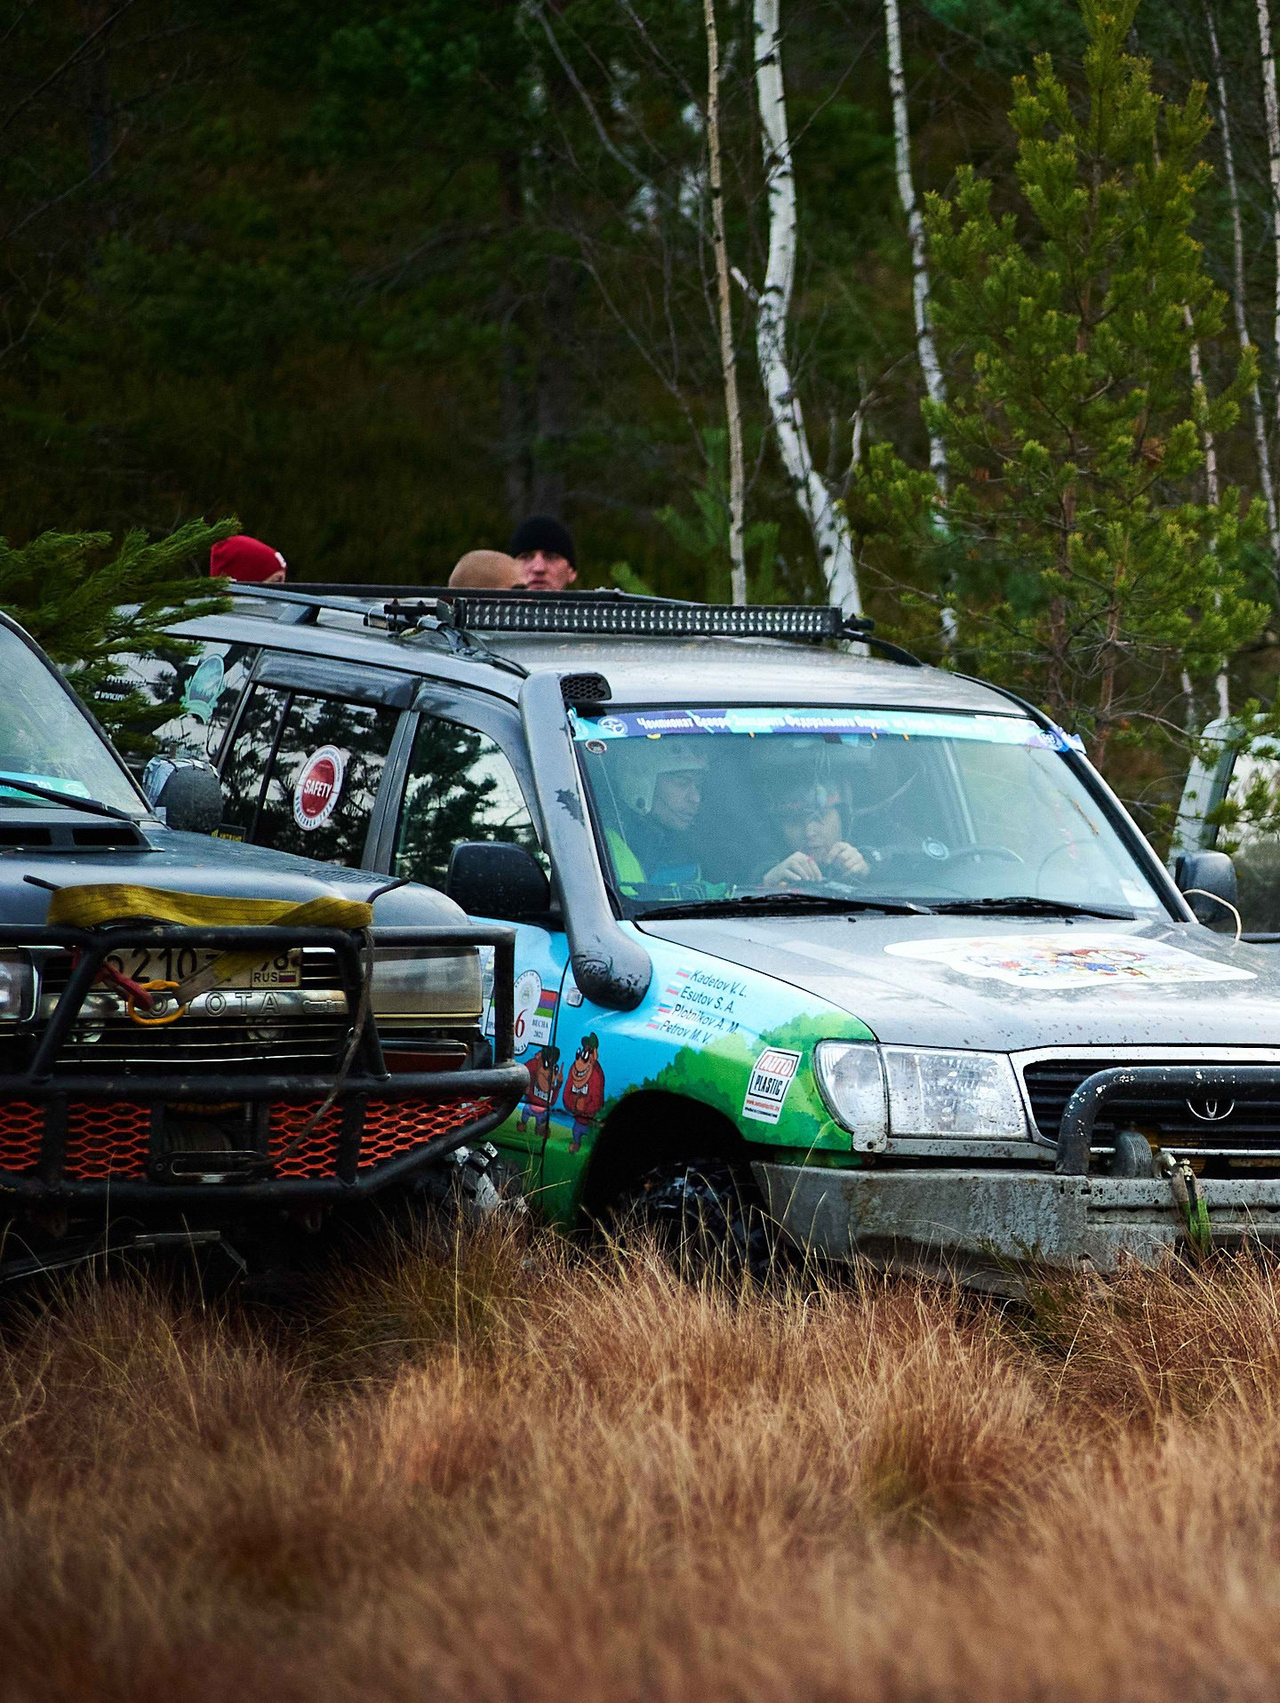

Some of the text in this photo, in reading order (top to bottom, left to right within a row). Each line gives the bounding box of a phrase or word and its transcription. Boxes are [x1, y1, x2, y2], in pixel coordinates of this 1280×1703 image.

[303, 779, 332, 799] SAFETY
[253, 971, 278, 983] RUS
[690, 969, 732, 991] Kadetov
[123, 991, 281, 1017] OOTA
[680, 985, 735, 1014] Esutov S. A.
[531, 1017, 549, 1029] ВЕСНА
[671, 1003, 740, 1035] Plotnikov A. M.
[659, 1020, 713, 1045] Petrov M. V.
[759, 1054, 795, 1077] AUTO
[753, 1074, 783, 1096] PLASTIC
